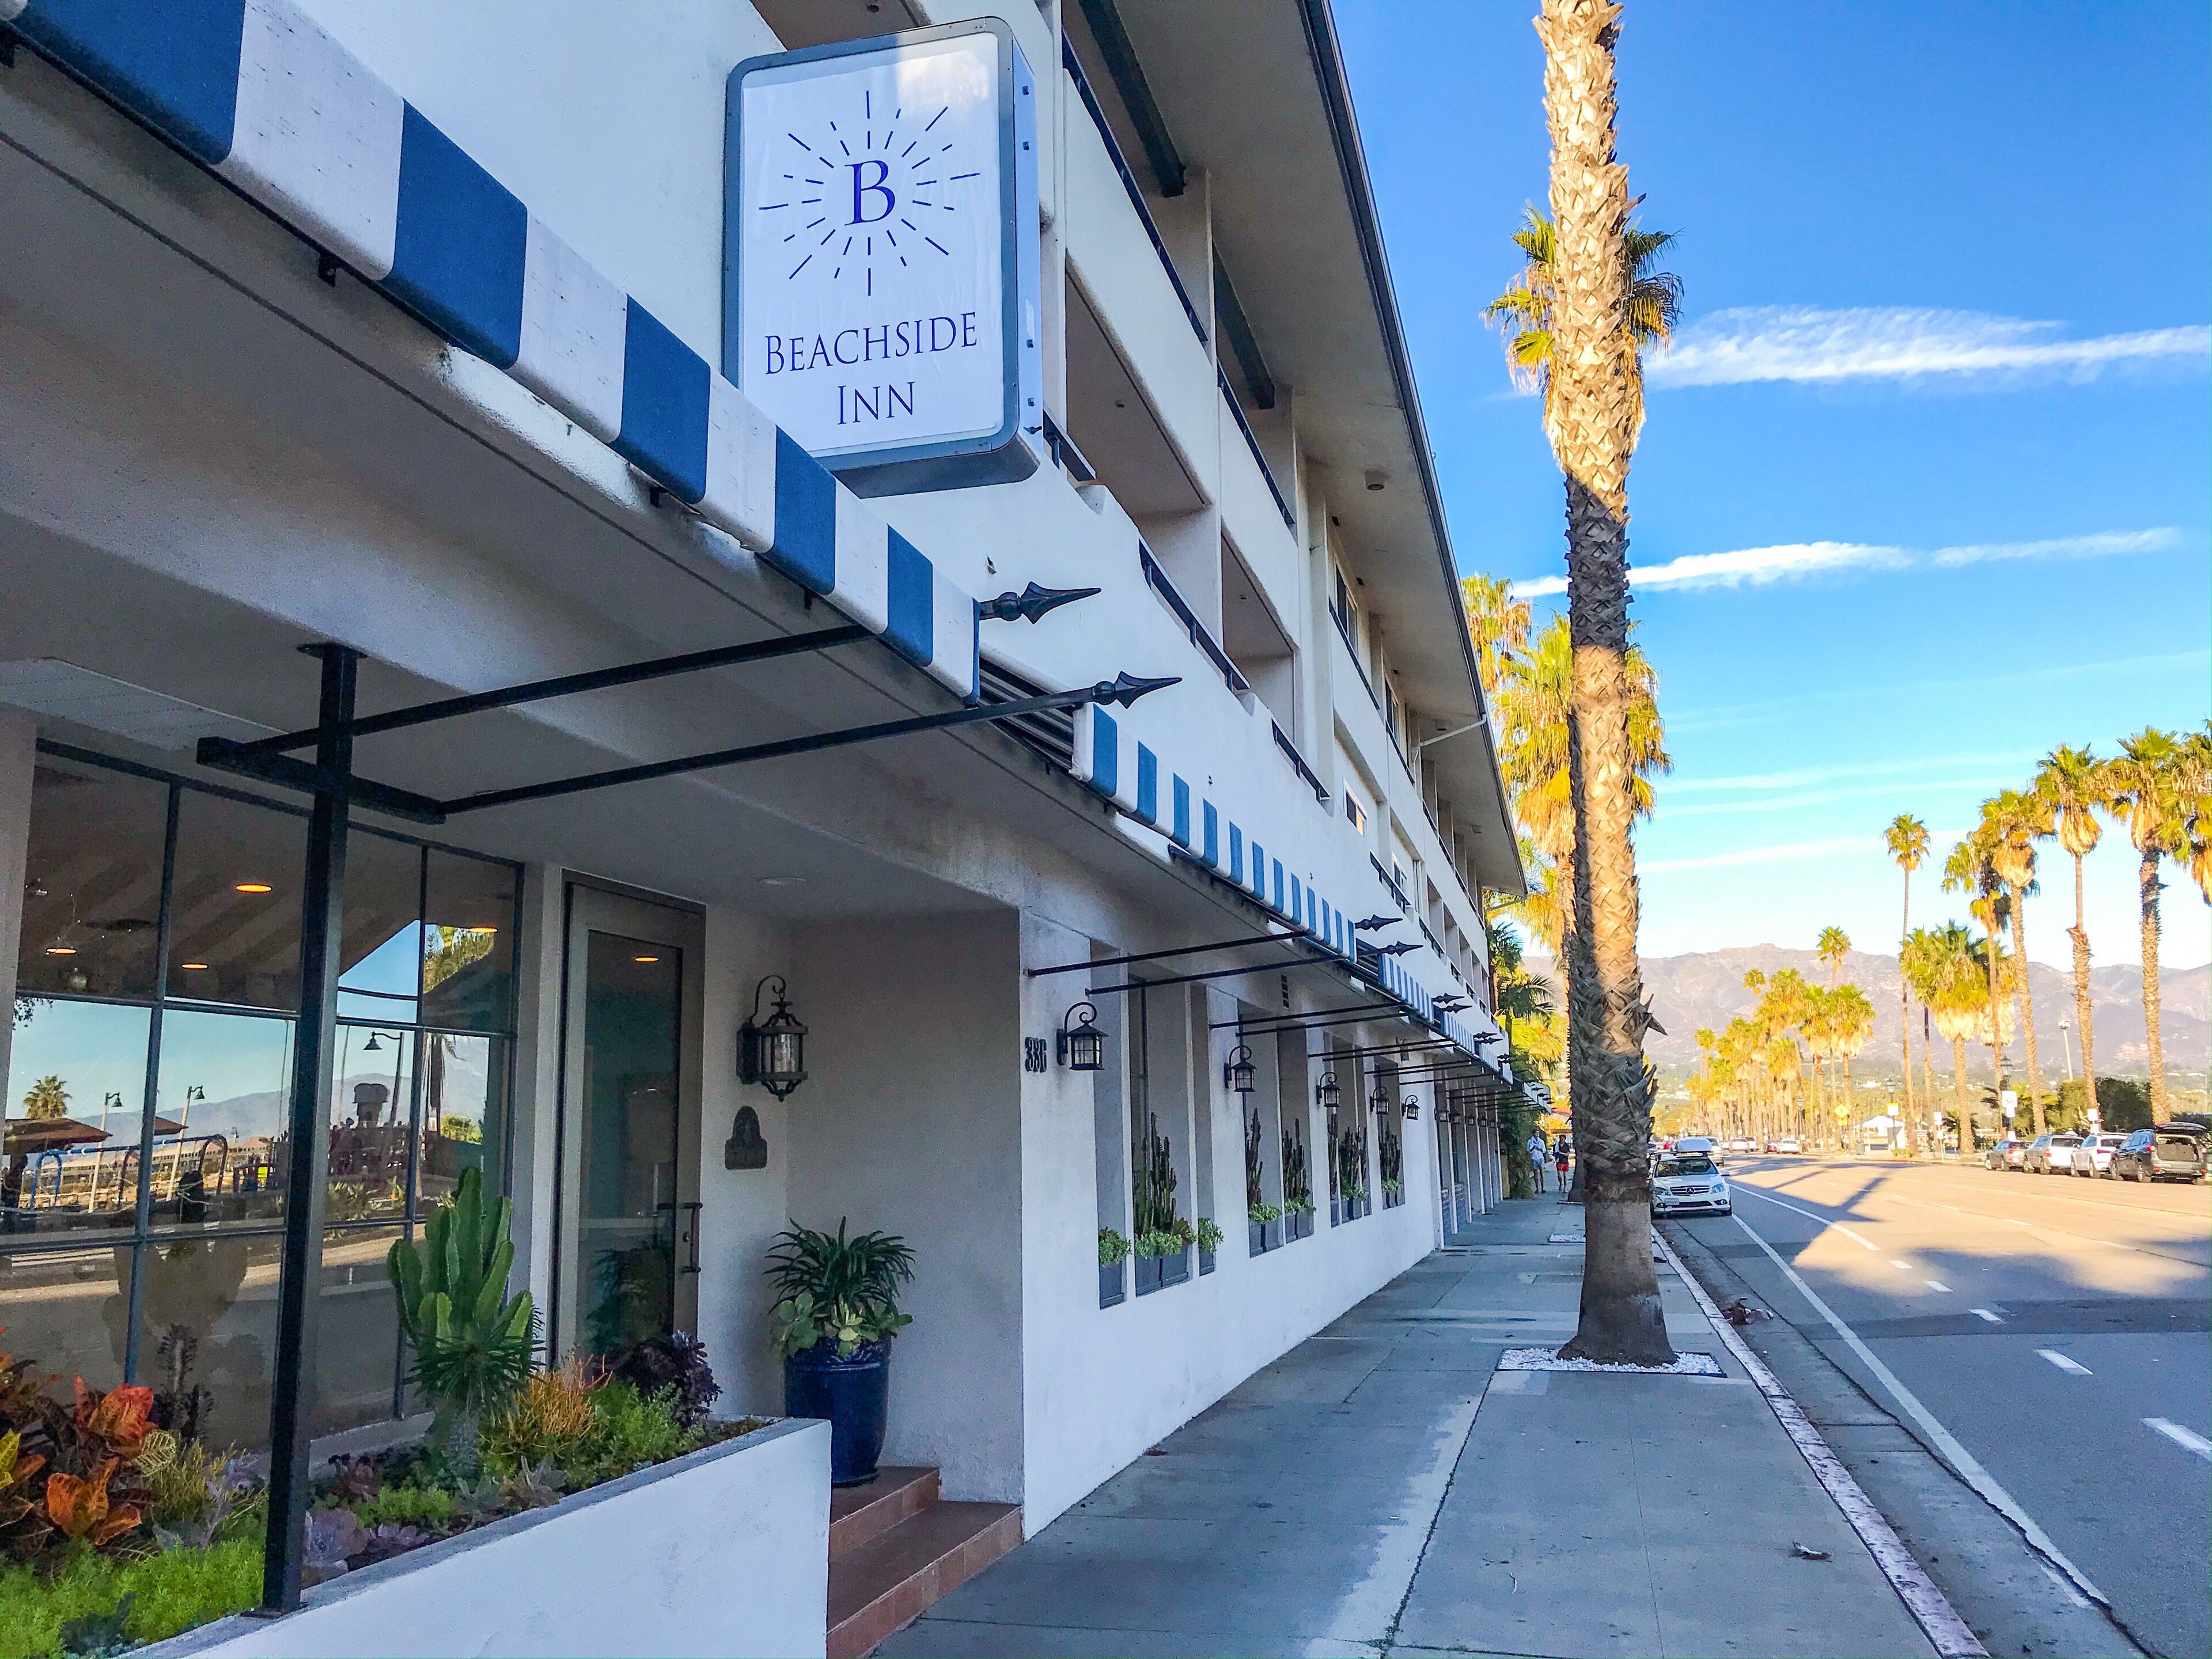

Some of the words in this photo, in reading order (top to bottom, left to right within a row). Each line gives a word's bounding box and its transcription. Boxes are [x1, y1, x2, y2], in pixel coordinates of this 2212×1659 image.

[844, 160, 896, 226] B
[764, 311, 978, 375] BEACHSIDE
[837, 381, 915, 425] INN
